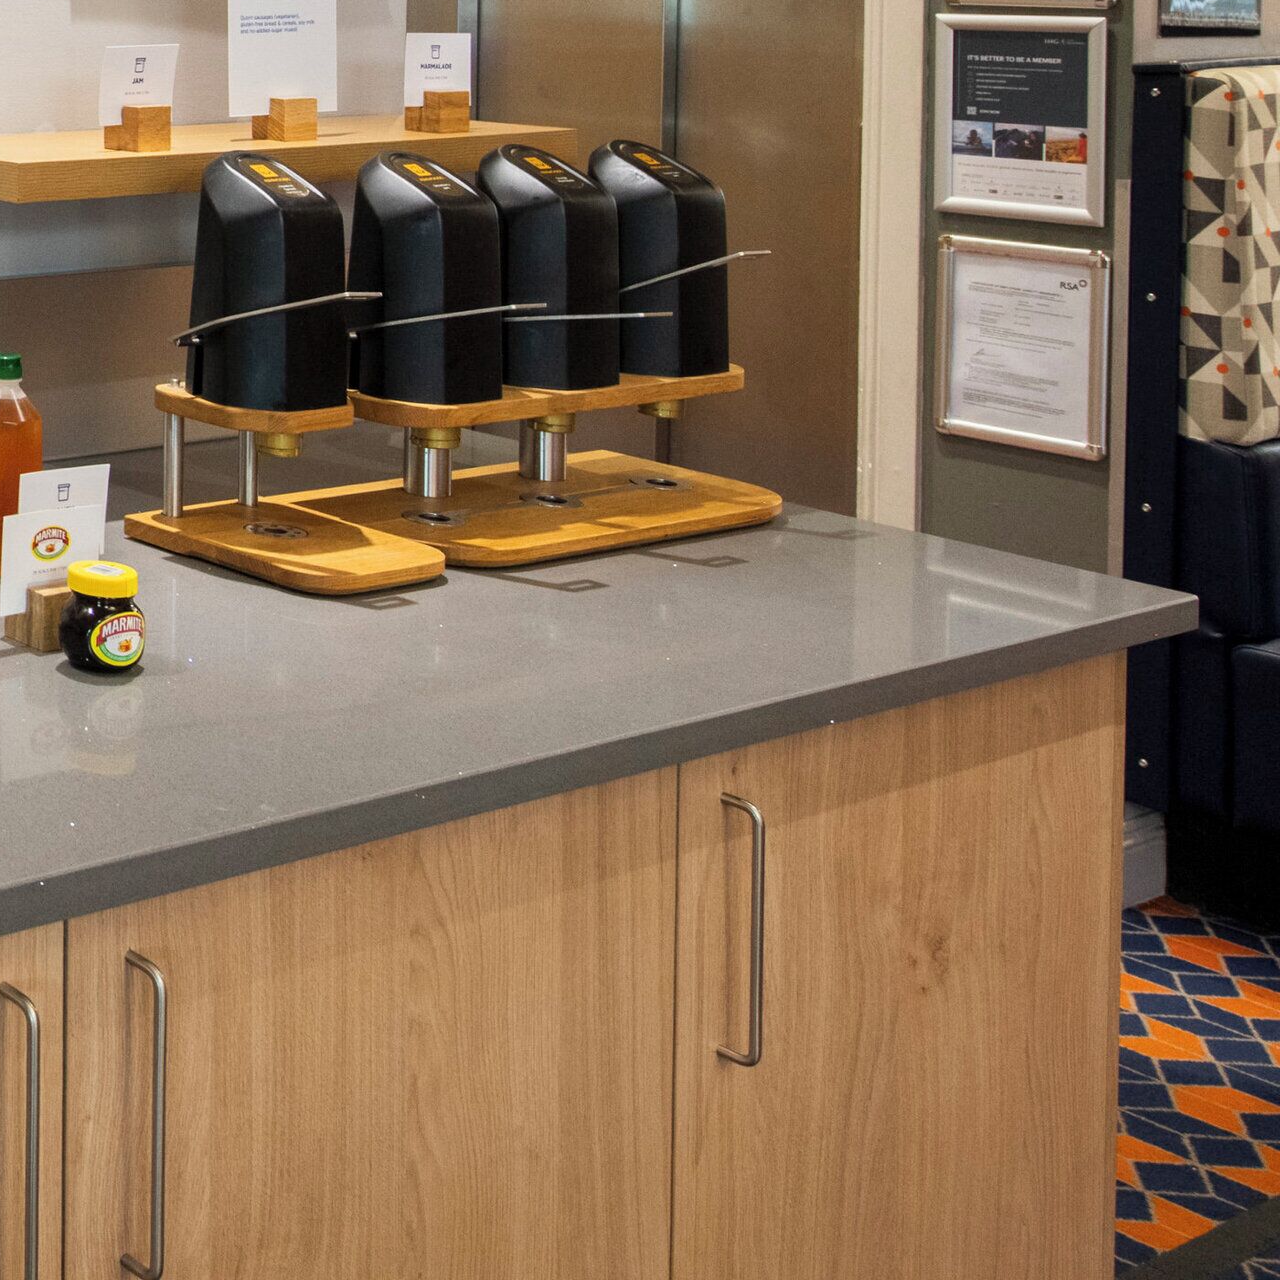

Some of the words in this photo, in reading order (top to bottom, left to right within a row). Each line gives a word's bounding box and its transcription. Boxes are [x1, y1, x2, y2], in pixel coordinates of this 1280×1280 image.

[1059, 281, 1079, 291] RSA
[35, 527, 67, 543] MARMITE
[101, 615, 144, 637] MARMITE
